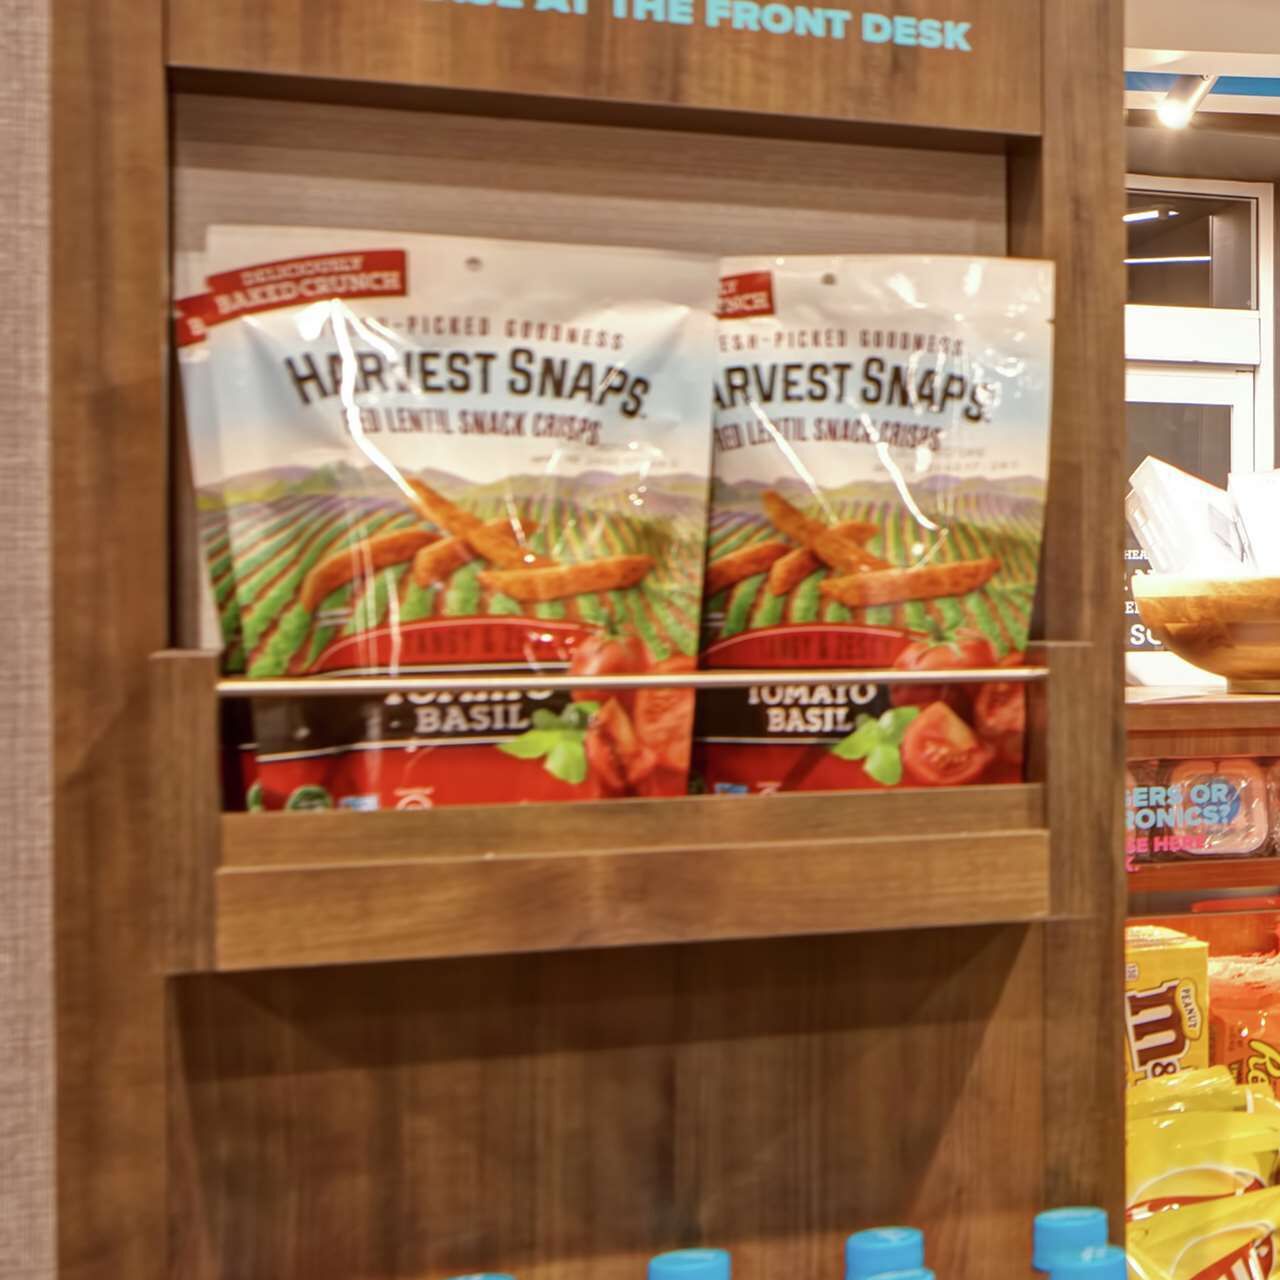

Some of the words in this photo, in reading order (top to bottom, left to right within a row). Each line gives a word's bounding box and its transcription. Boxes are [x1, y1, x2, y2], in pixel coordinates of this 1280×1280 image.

[611, 0, 694, 25] THE
[706, 0, 851, 39] FRONT
[862, 12, 972, 51] DESK
[505, 320, 625, 351] GOODNESS
[859, 328, 964, 357] GOODNESS
[509, 348, 650, 419] SNAPS
[713, 362, 853, 410] ARVEST
[861, 357, 993, 423] SNAPS
[387, 408, 452, 435] LENTIL
[459, 409, 526, 437] SNACK
[531, 411, 602, 446] CRISPS
[814, 417, 876, 444] SNACK
[748, 684, 878, 706] TOMATO
[417, 701, 530, 735] BASIL
[767, 708, 854, 734] BASIL
[1126, 783, 1183, 807] ERS
[1190, 783, 1228, 805] OR
[1180, 987, 1198, 1030] PEANUT
